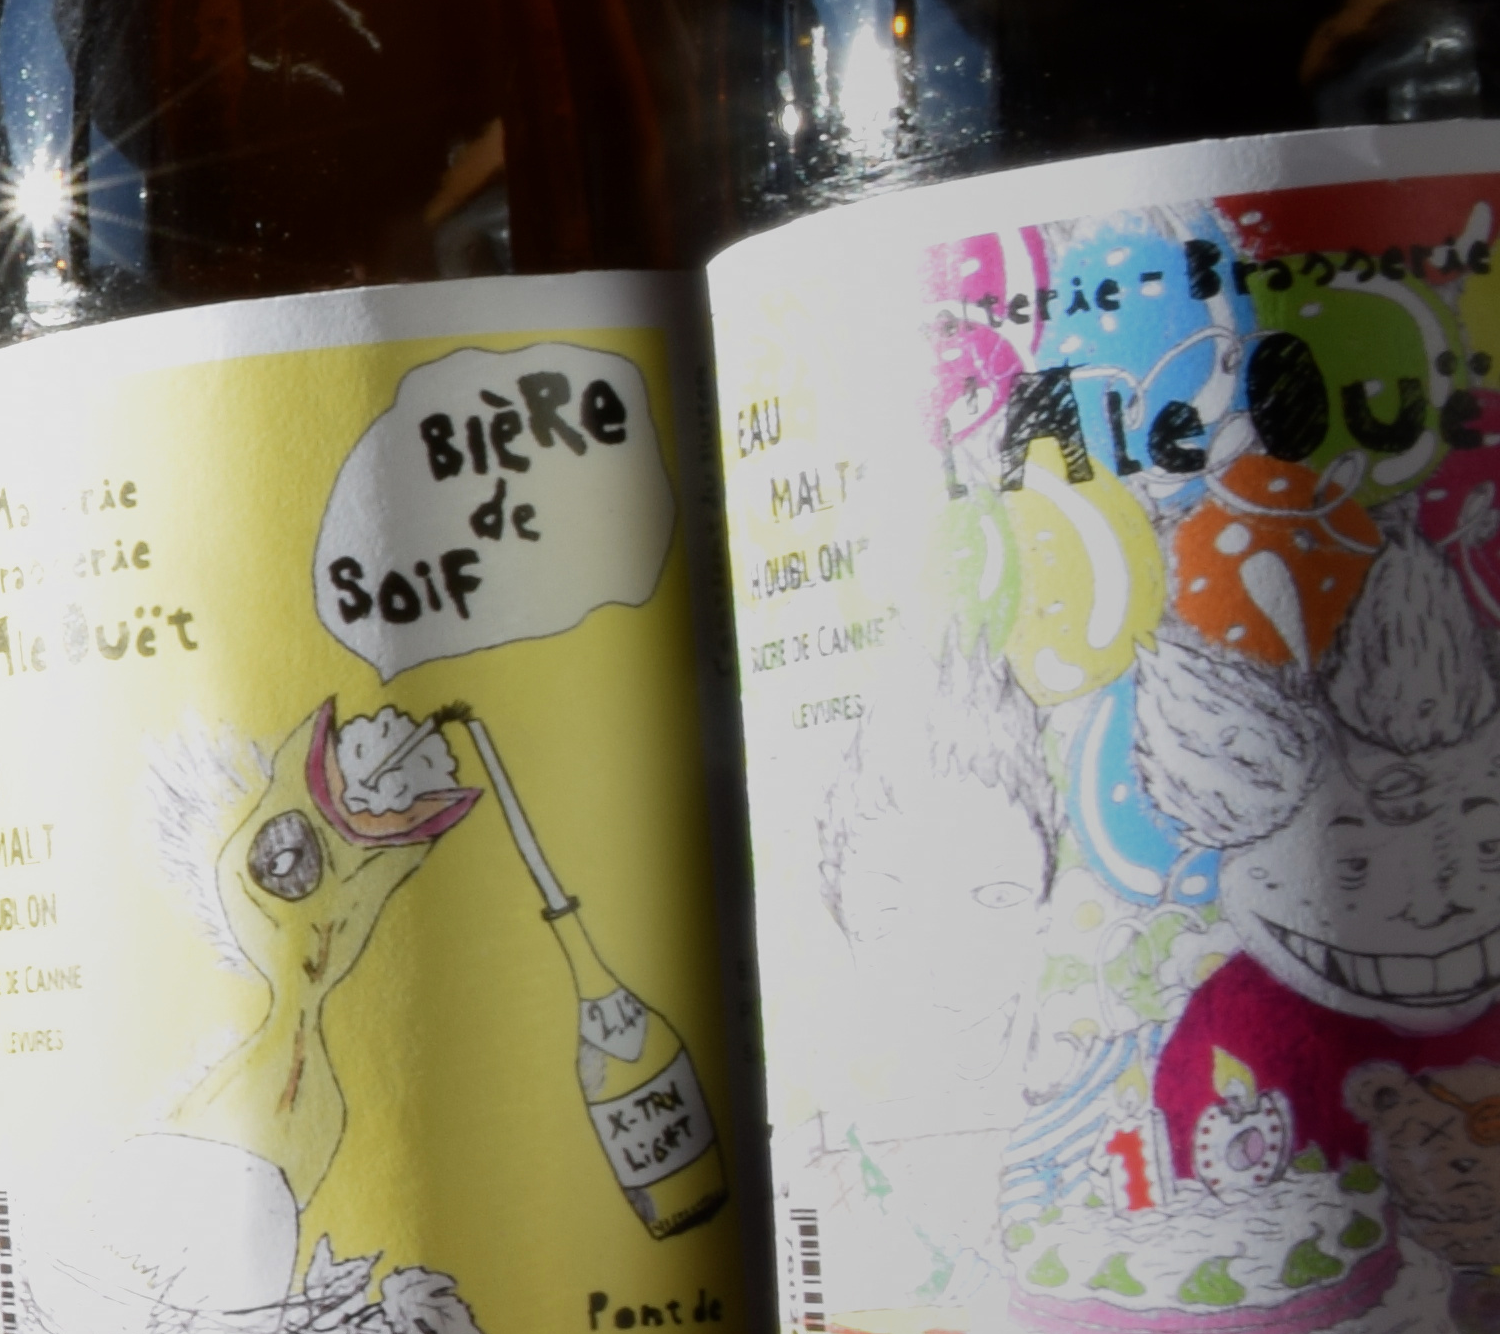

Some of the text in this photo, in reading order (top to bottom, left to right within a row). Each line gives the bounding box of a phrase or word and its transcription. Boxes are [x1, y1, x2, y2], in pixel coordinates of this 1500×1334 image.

[937, 238, 1492, 336] alterie Brasserie
[737, 397, 781, 458] EAU
[943, 330, 1492, 499] l'Ale Ouë
[469, 478, 541, 543] de
[62, 603, 198, 665] Ouët
[588, 1288, 723, 1331] Pont de
